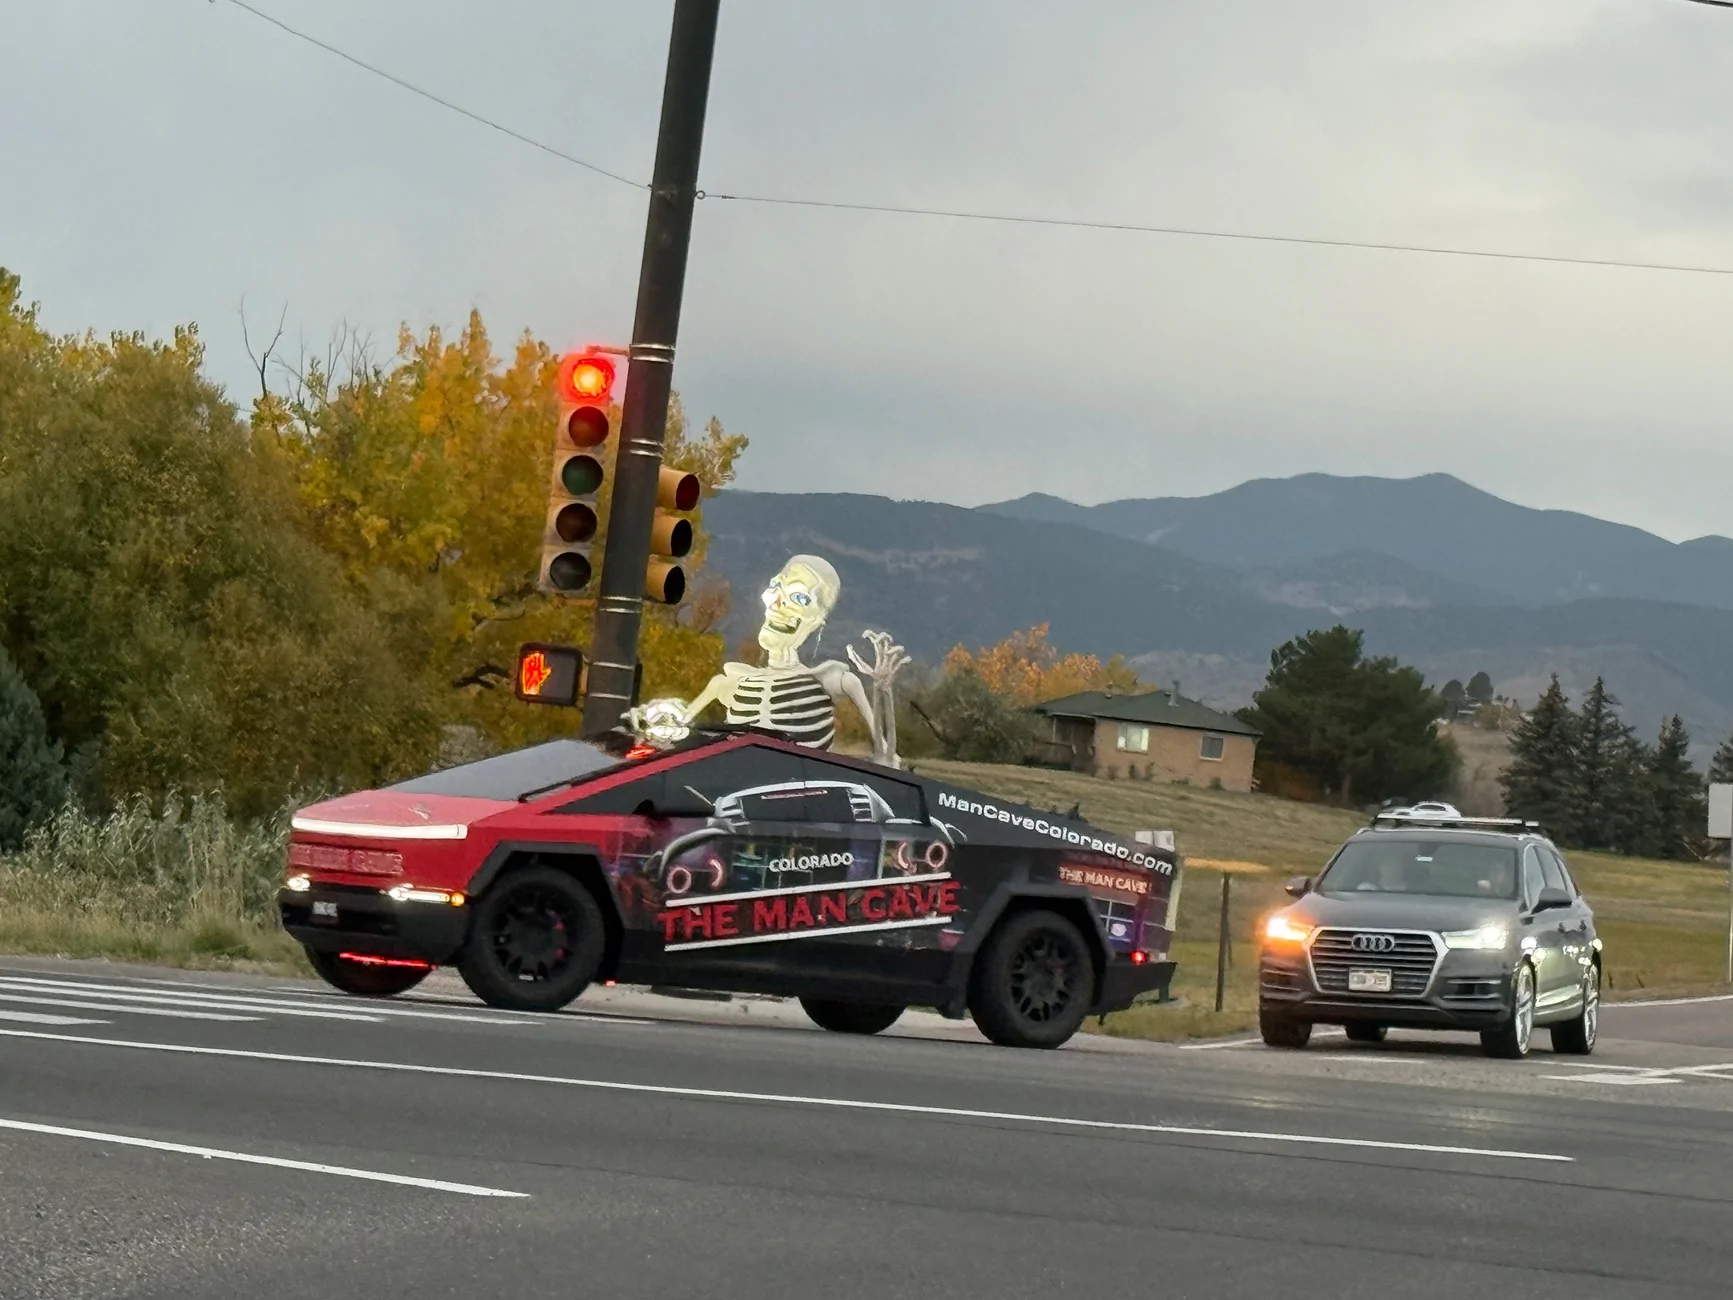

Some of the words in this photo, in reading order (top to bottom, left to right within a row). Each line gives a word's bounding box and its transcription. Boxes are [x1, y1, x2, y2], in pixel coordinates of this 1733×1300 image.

[769, 852, 854, 872] COLORADO
[938, 792, 1173, 876] ManCaveColorado.com
[658, 904, 739, 941] THE
[753, 892, 846, 931] MAN
[861, 881, 961, 921] CAVE
